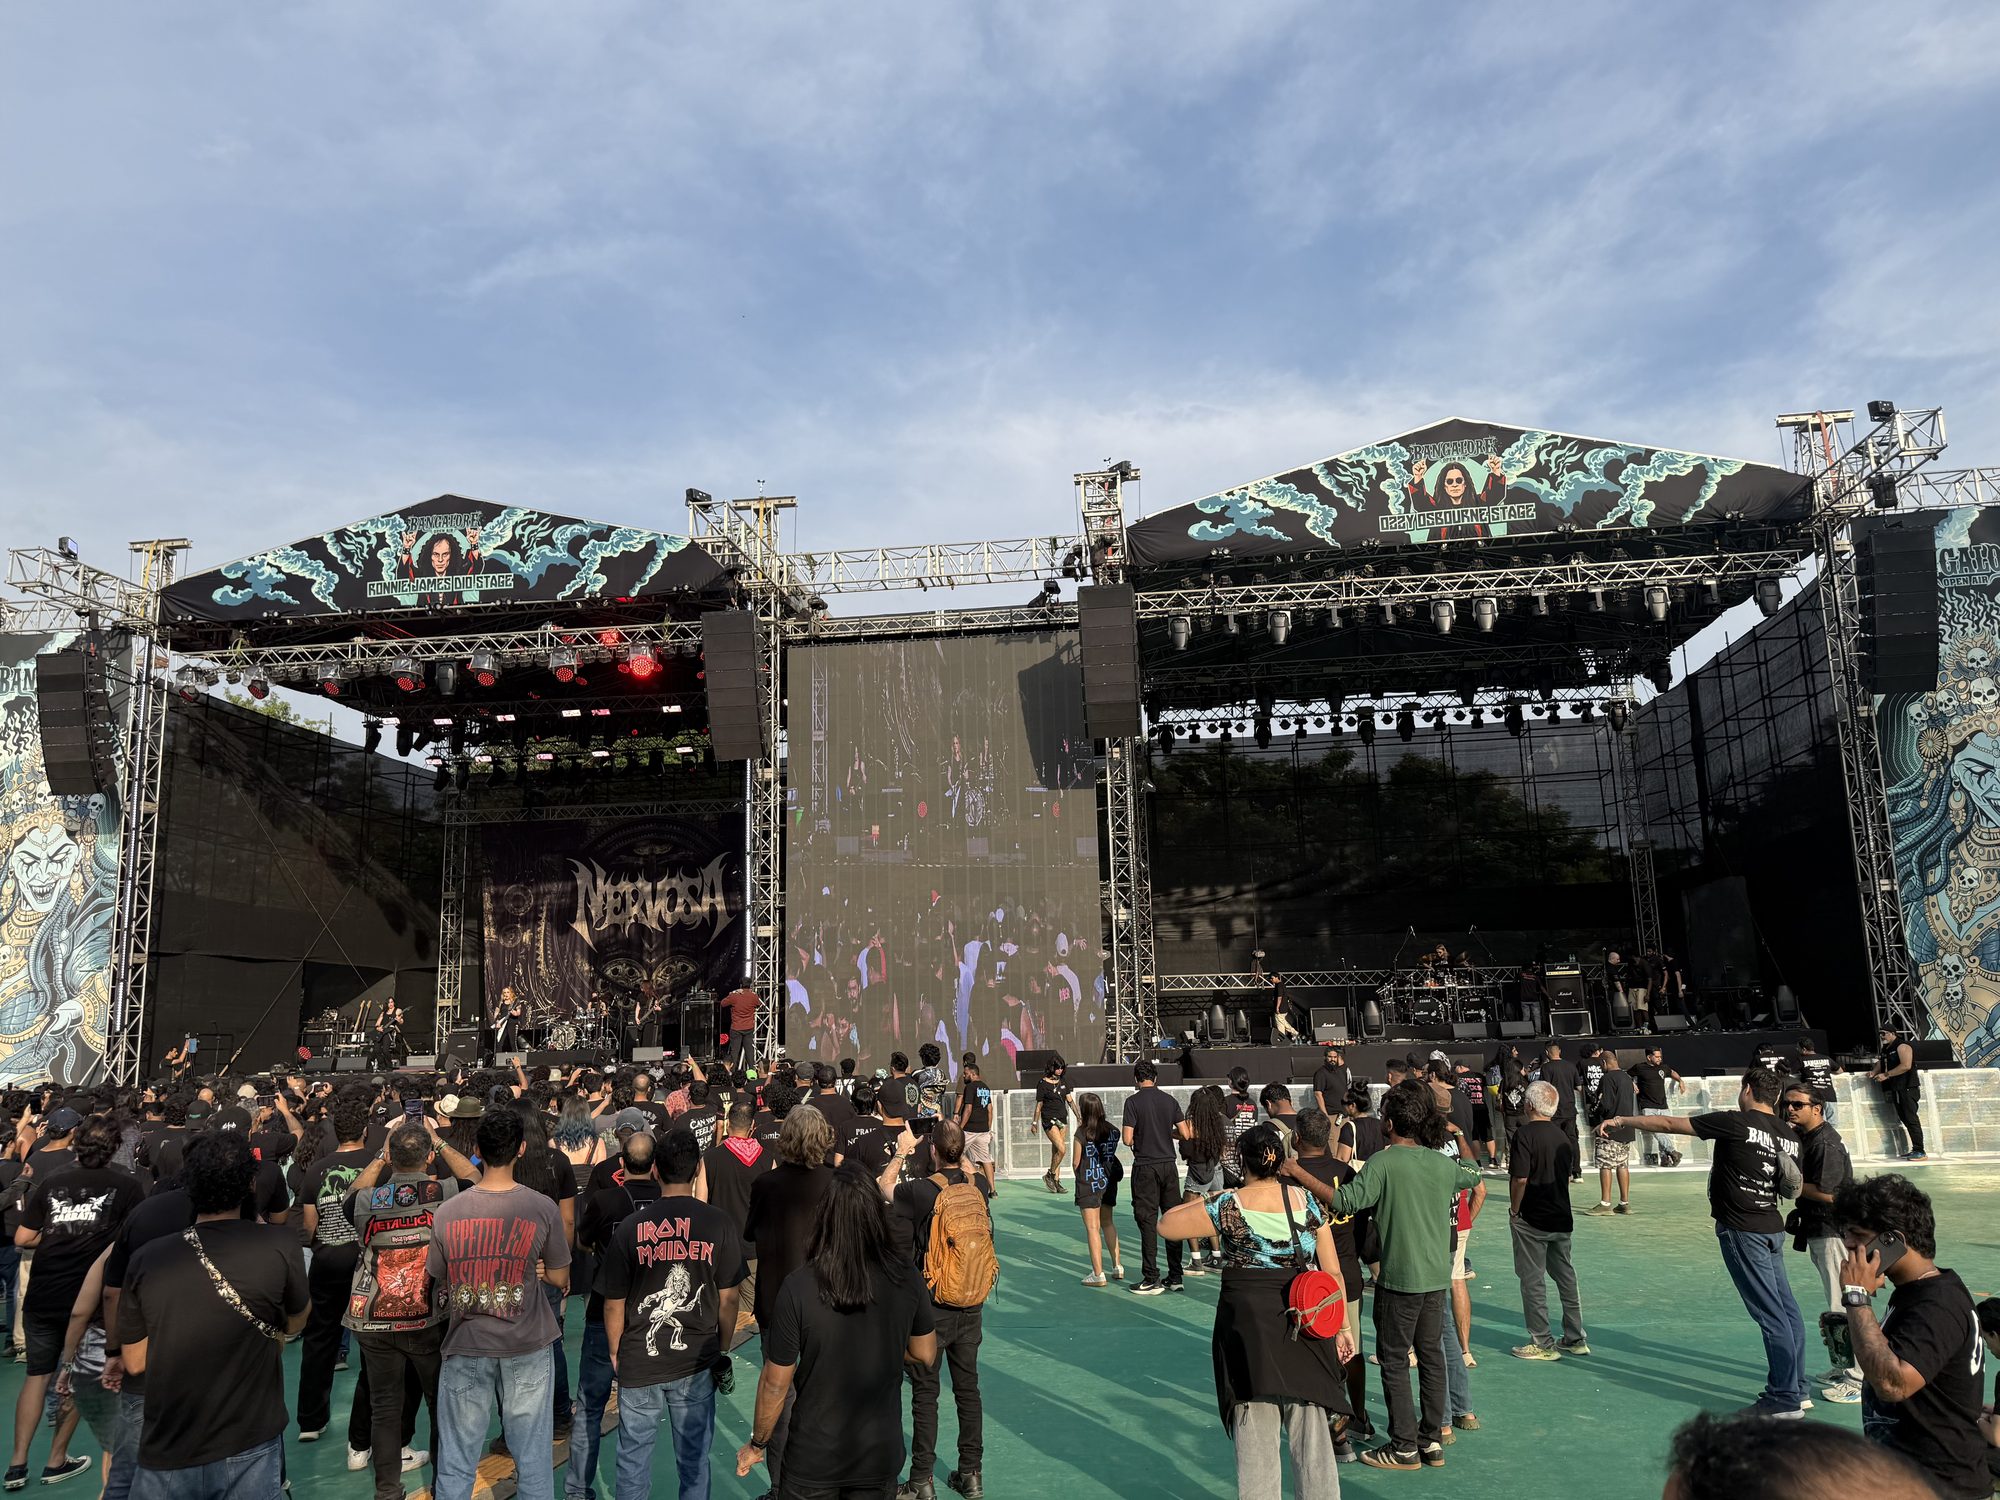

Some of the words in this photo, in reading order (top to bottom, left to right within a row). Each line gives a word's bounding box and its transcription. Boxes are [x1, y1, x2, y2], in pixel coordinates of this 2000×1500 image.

[1410, 437, 1496, 461] BANGALORE
[406, 511, 482, 533] BANGALORE
[1380, 514, 1415, 530] OZZY
[1417, 507, 1489, 528] OSBOURNE
[1491, 503, 1535, 521] STAGE
[368, 580, 410, 596] RONNIE
[411, 577, 452, 592] JAMES
[454, 575, 474, 590] DIO
[476, 574, 514, 588] STAGE
[1943, 577, 1970, 587] OPEN
[1971, 575, 1989, 585] AIR
[566, 852, 736, 953] NERVOSA
[690, 1118, 706, 1130] CAN
[52, 1211, 97, 1223] SABBATH
[62, 1203, 92, 1214] BLACK
[504, 1215, 537, 1260] FOR
[637, 1217, 691, 1243] IRON
[636, 1240, 714, 1268] MAIDEN
